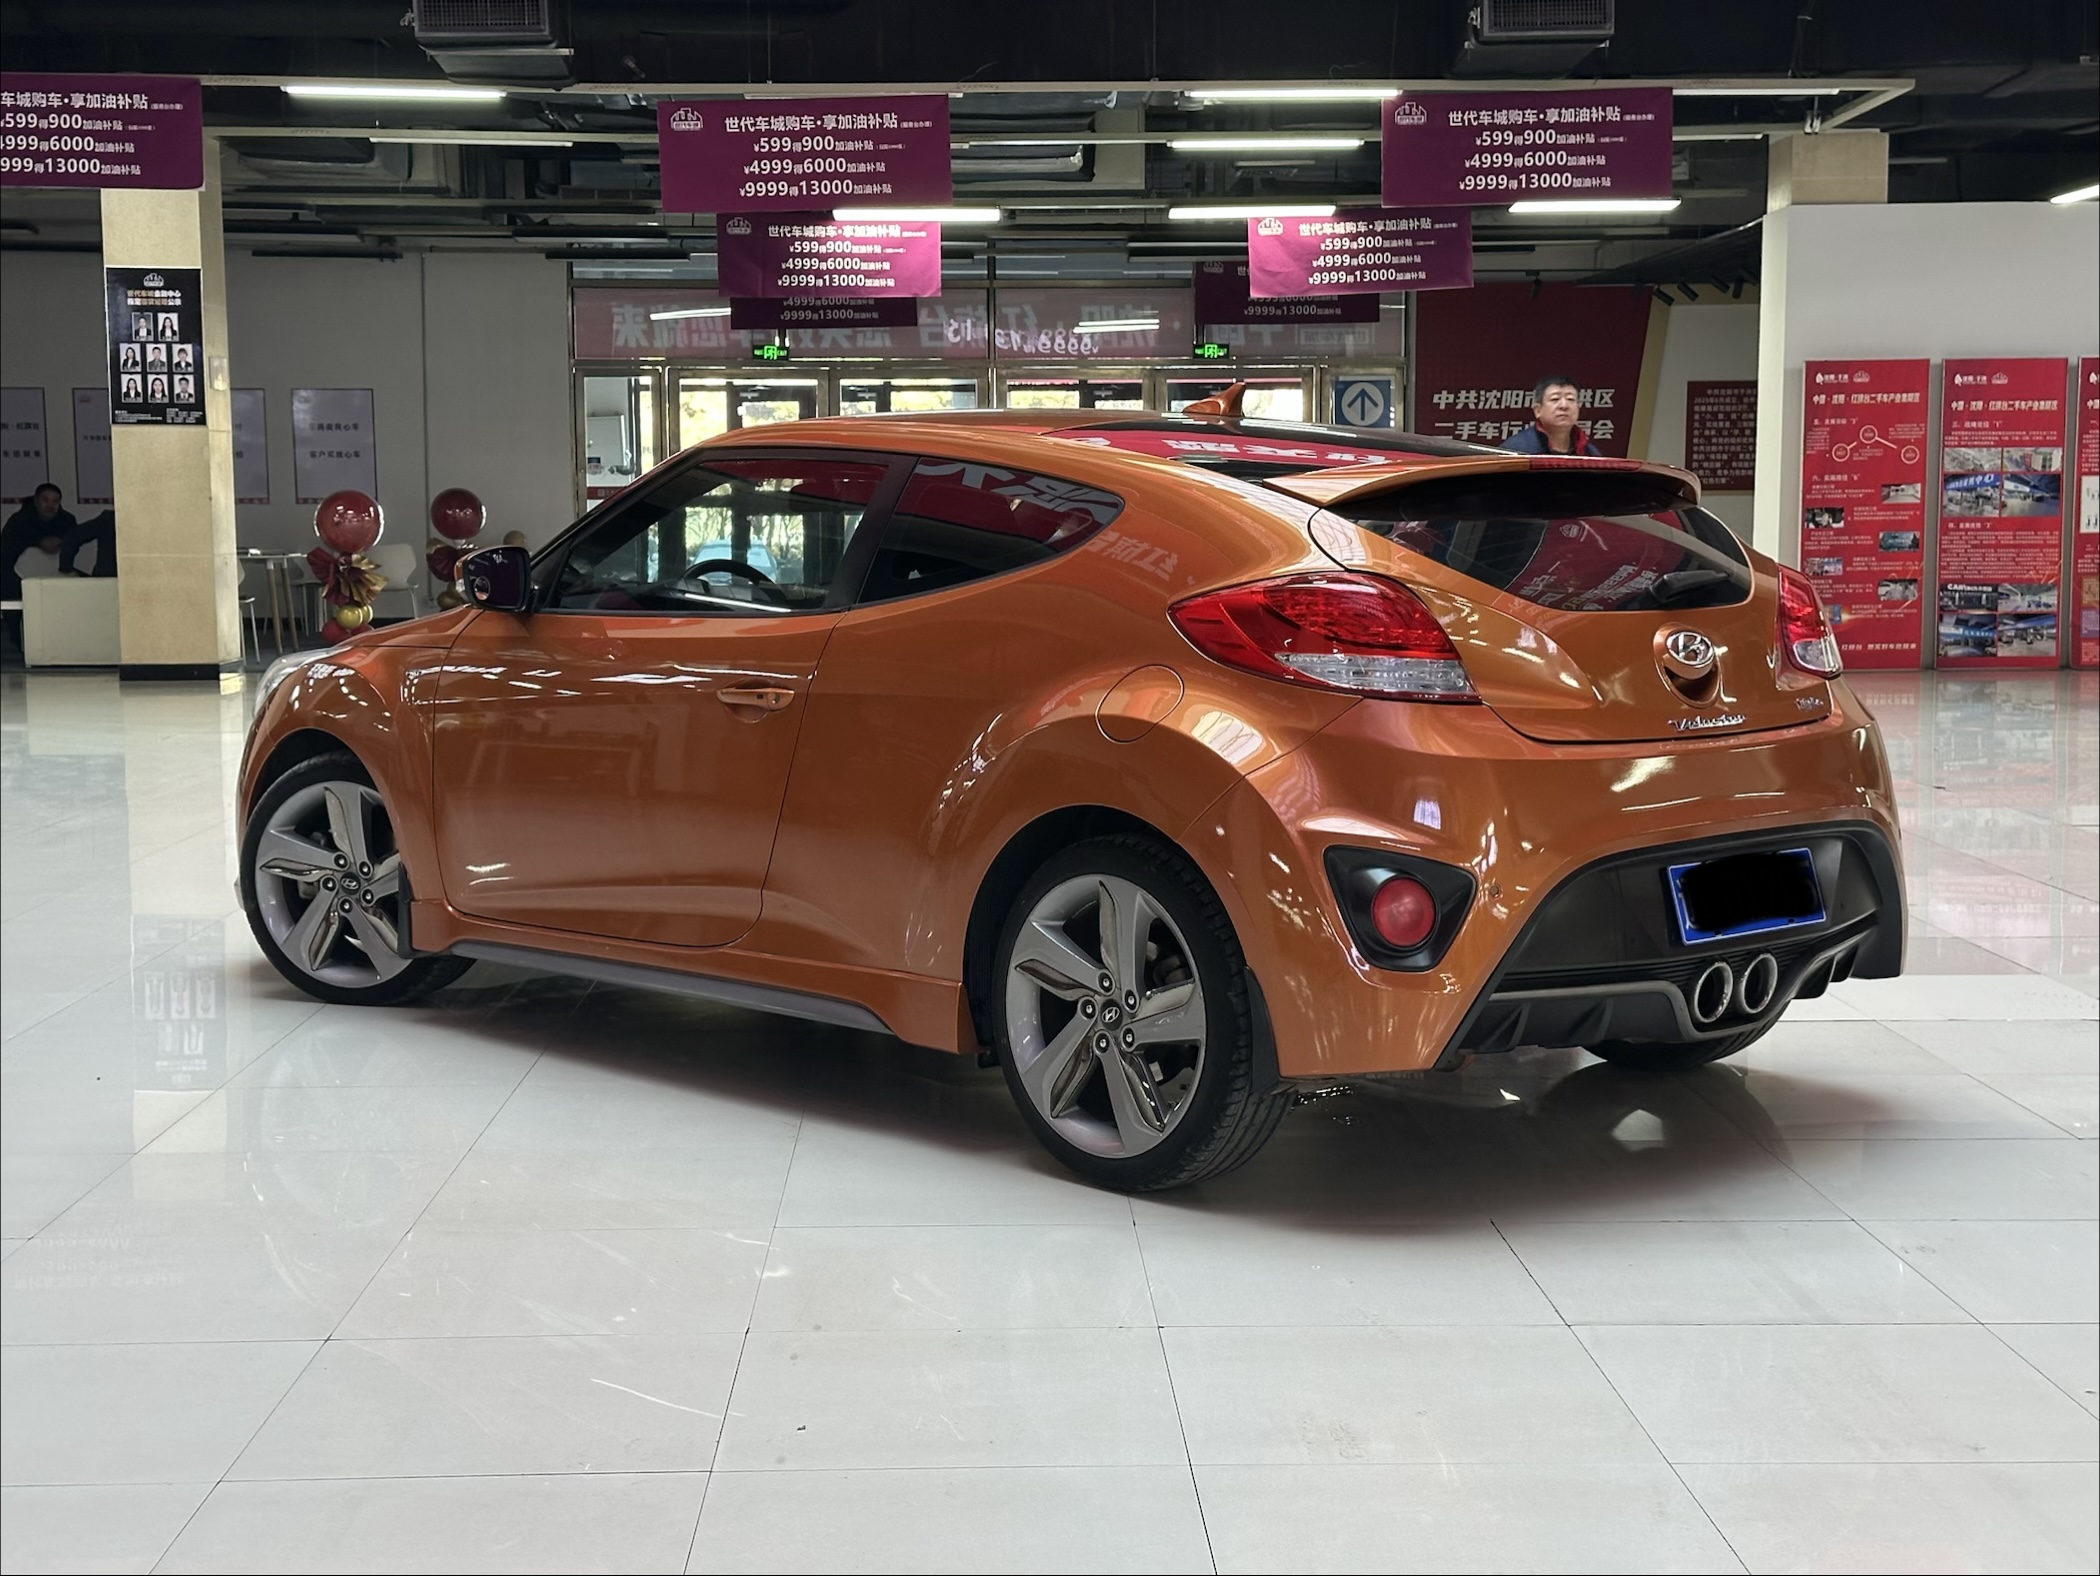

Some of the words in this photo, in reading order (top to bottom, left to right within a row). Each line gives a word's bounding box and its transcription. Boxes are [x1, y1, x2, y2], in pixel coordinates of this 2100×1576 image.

[0, 91, 148, 110] 车城购车·享加油补贴
[724, 112, 898, 133] 世代车城购车·享加油补贴
[1448, 106, 1621, 127] 世代车城购车·享加油补贴
[753, 135, 873, 152] ¥599得900加油补贴
[1475, 129, 1595, 146] ¥599得900加油补贴
[743, 157, 885, 175] ¥4999得6000加油补贴
[1465, 151, 1606, 168] ¥4999得6000加油补贴
[739, 180, 892, 197] ¥9999得13000加油补贴
[1459, 173, 1611, 190] ¥9999得13000加油补贴
[768, 224, 901, 238] 世代车城购车·享加油补贴
[1299, 217, 1432, 236] 世代车城购车·享加油补贴
